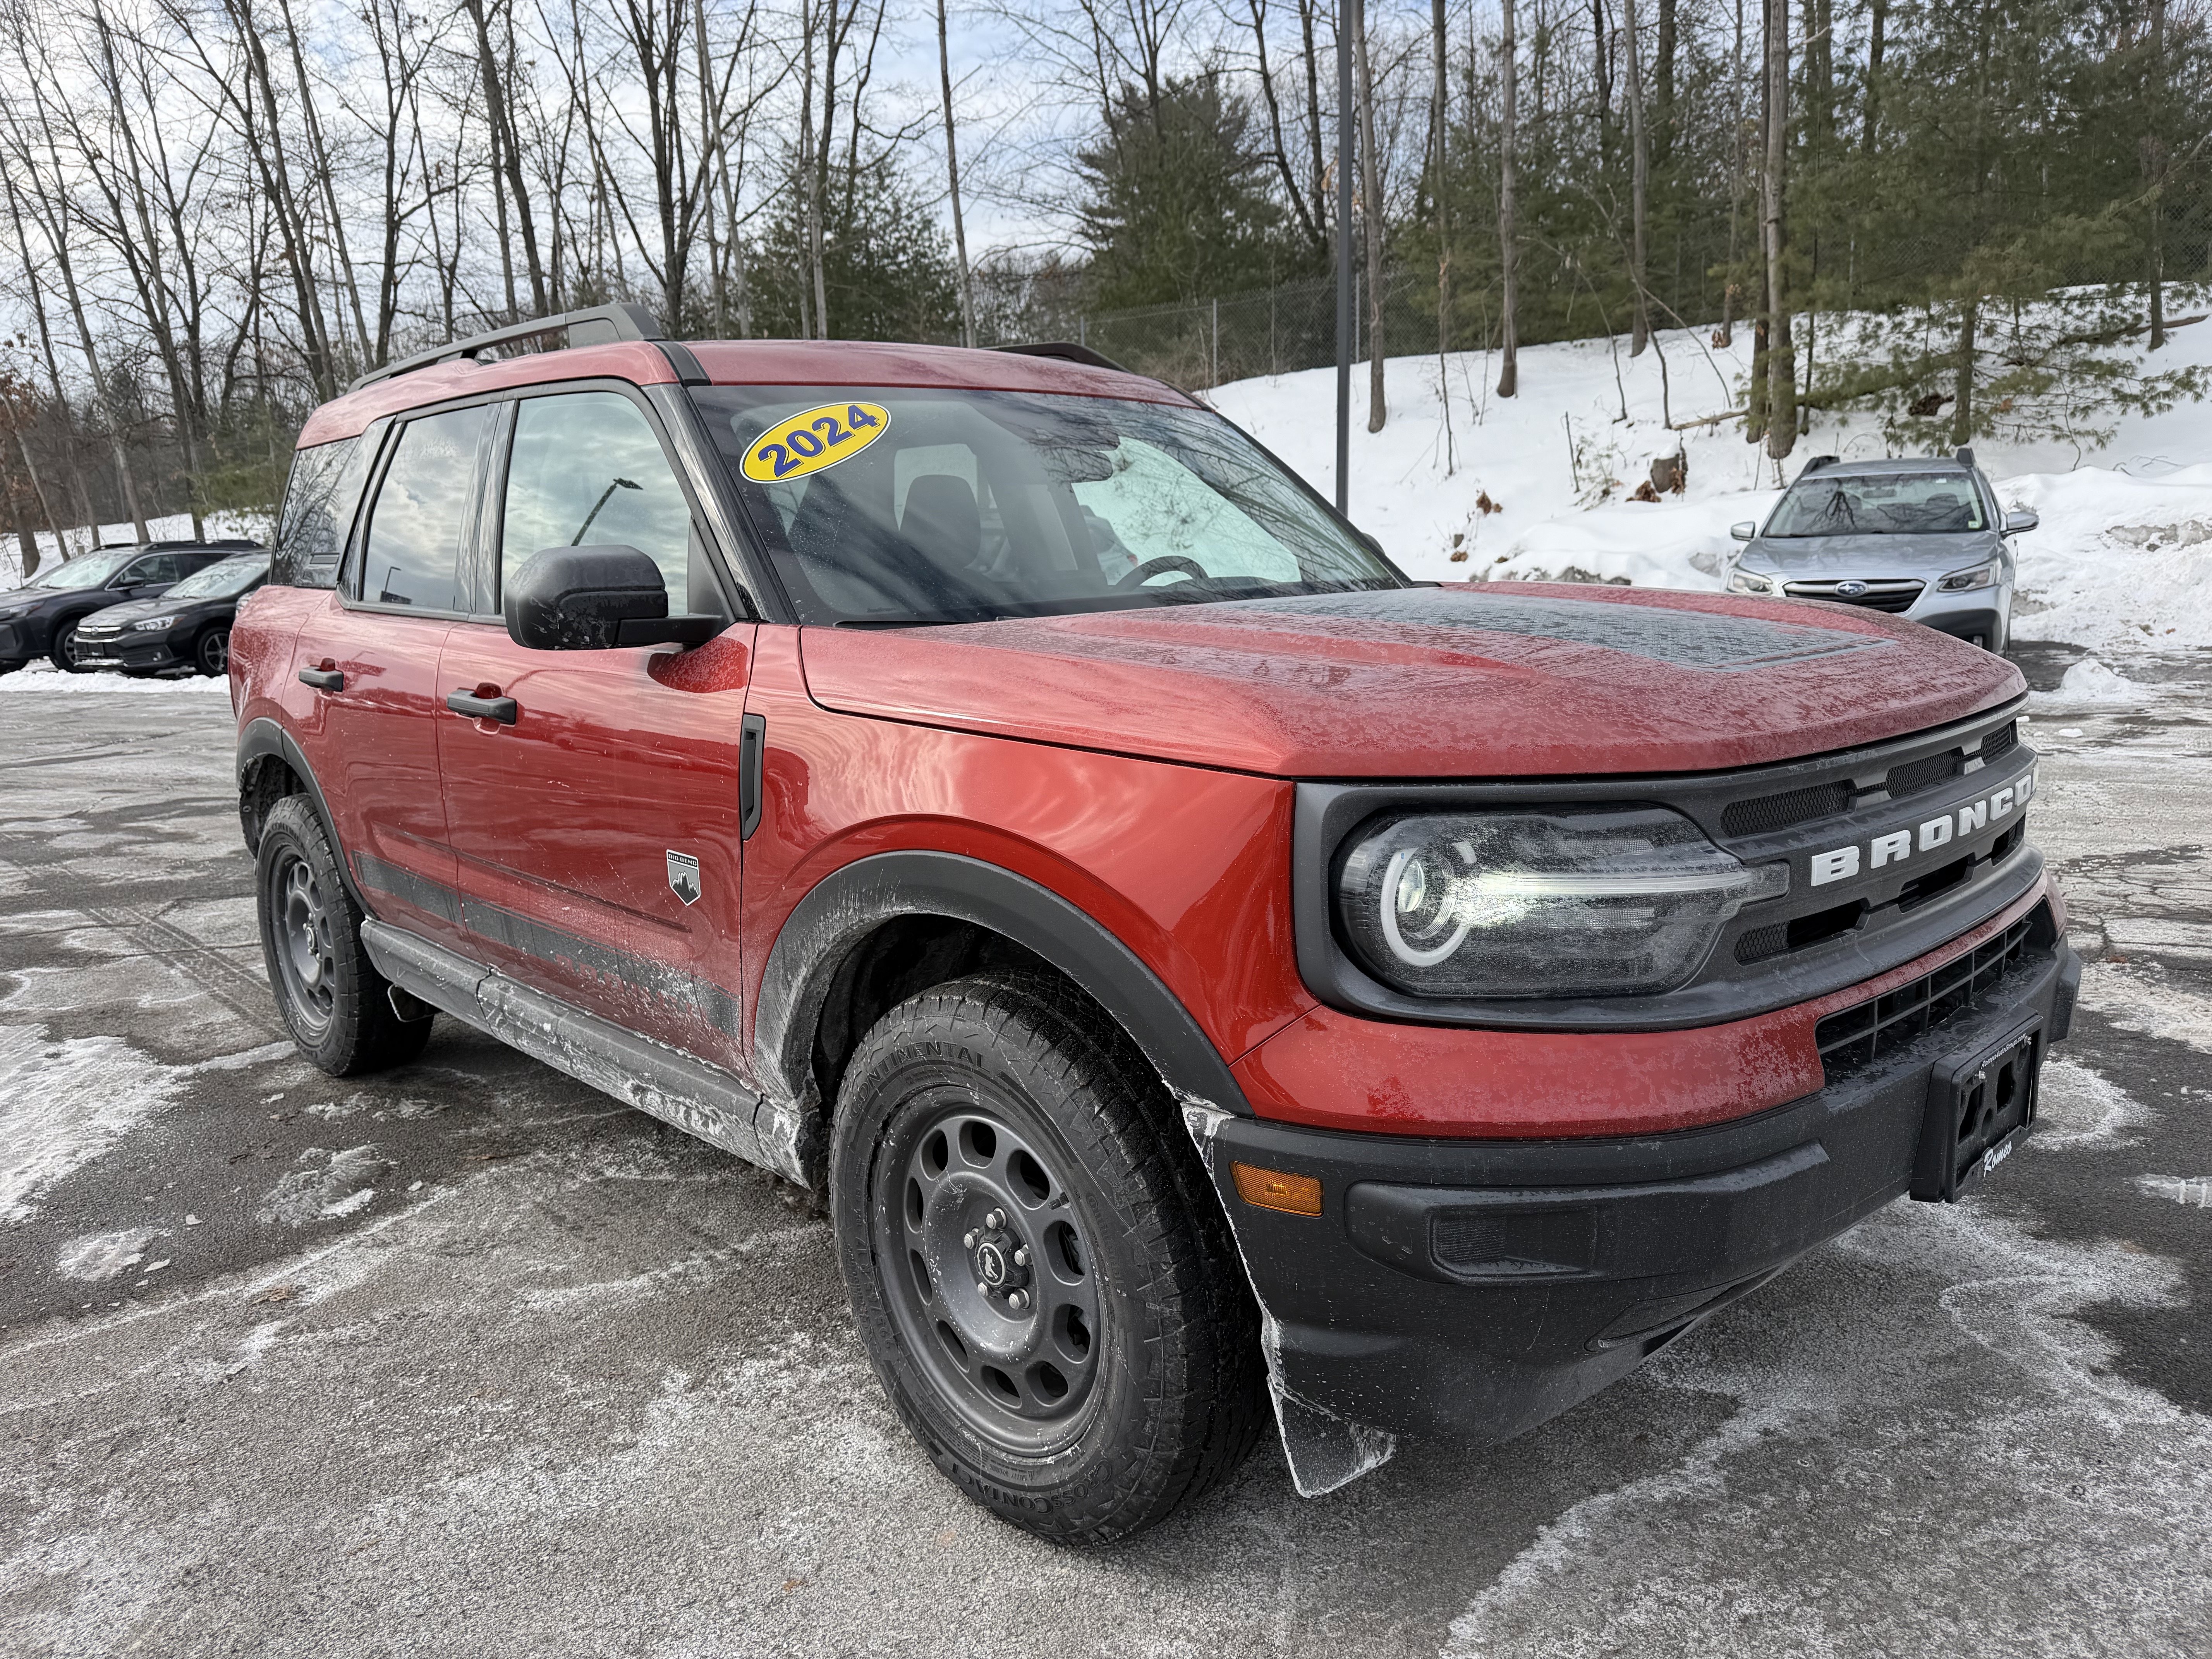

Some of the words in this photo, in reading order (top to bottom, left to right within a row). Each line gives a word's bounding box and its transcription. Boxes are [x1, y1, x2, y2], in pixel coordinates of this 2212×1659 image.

[758, 404, 880, 478] 2024
[680, 857, 697, 866] BEND
[1811, 774, 2032, 887] BRONCO
[850, 1040, 990, 1118] CONTINENTAL
[1984, 1141, 2012, 1178] Romeo
